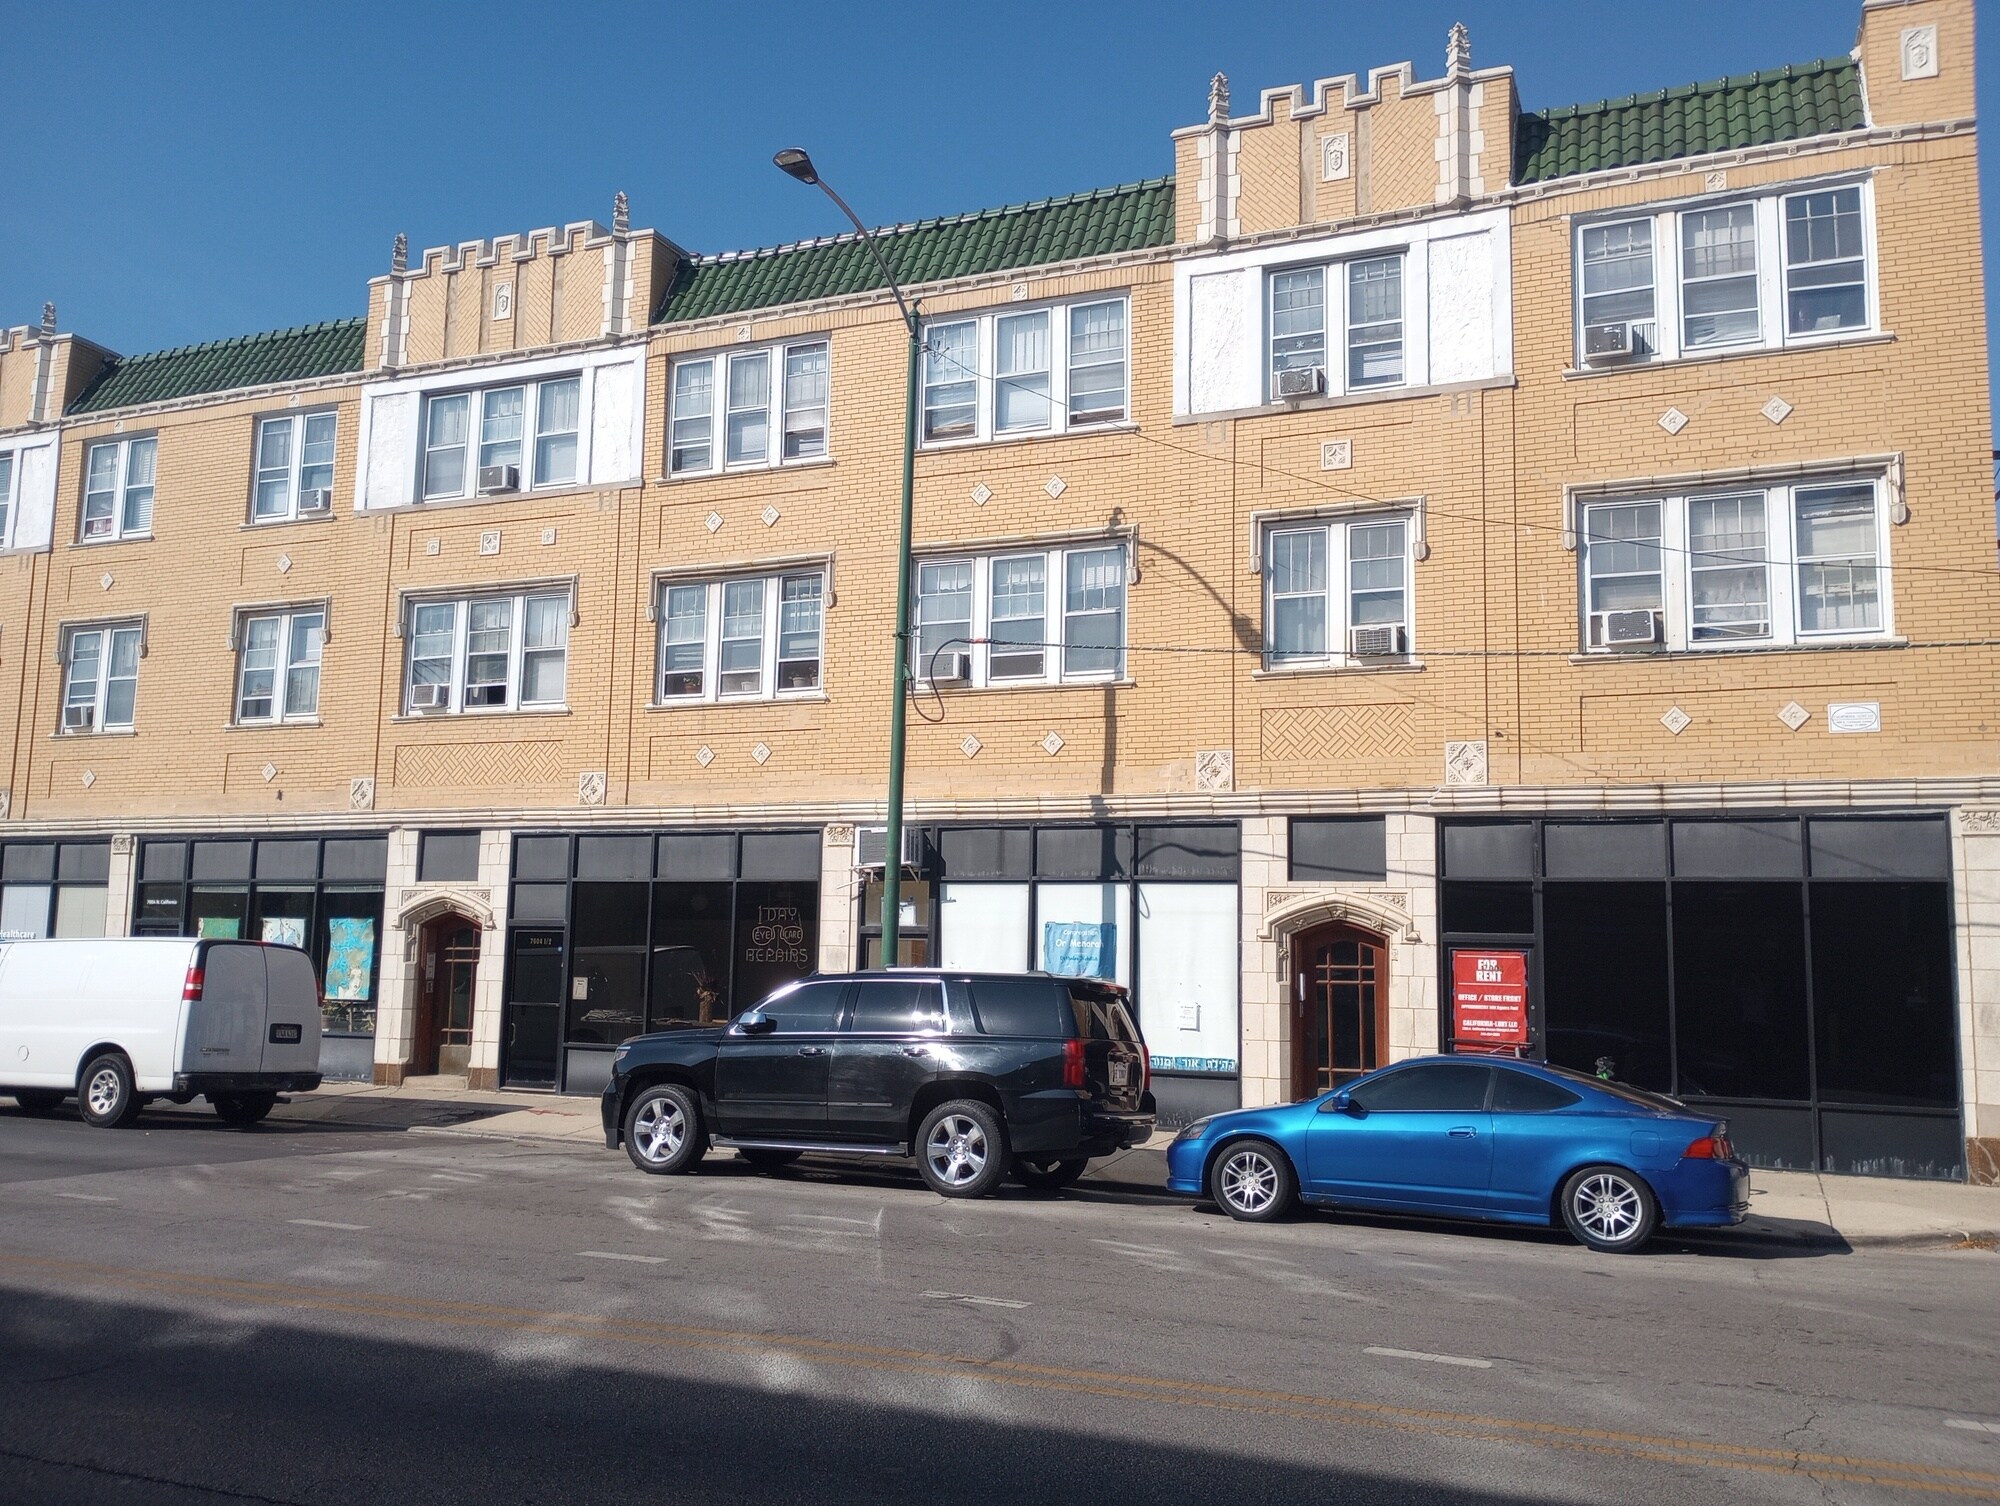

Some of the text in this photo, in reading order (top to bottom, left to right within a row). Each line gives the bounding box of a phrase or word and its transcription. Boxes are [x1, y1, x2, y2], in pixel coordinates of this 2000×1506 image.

[767, 907, 797, 921] DAY
[755, 930, 801, 940] EYE CARE
[1070, 939, 1104, 949] Menorah
[745, 948, 808, 963] REPAIRS
[1477, 959, 1498, 970] FOR
[1476, 970, 1502, 982] RENT
[1150, 1056, 1172, 1068] מנור
